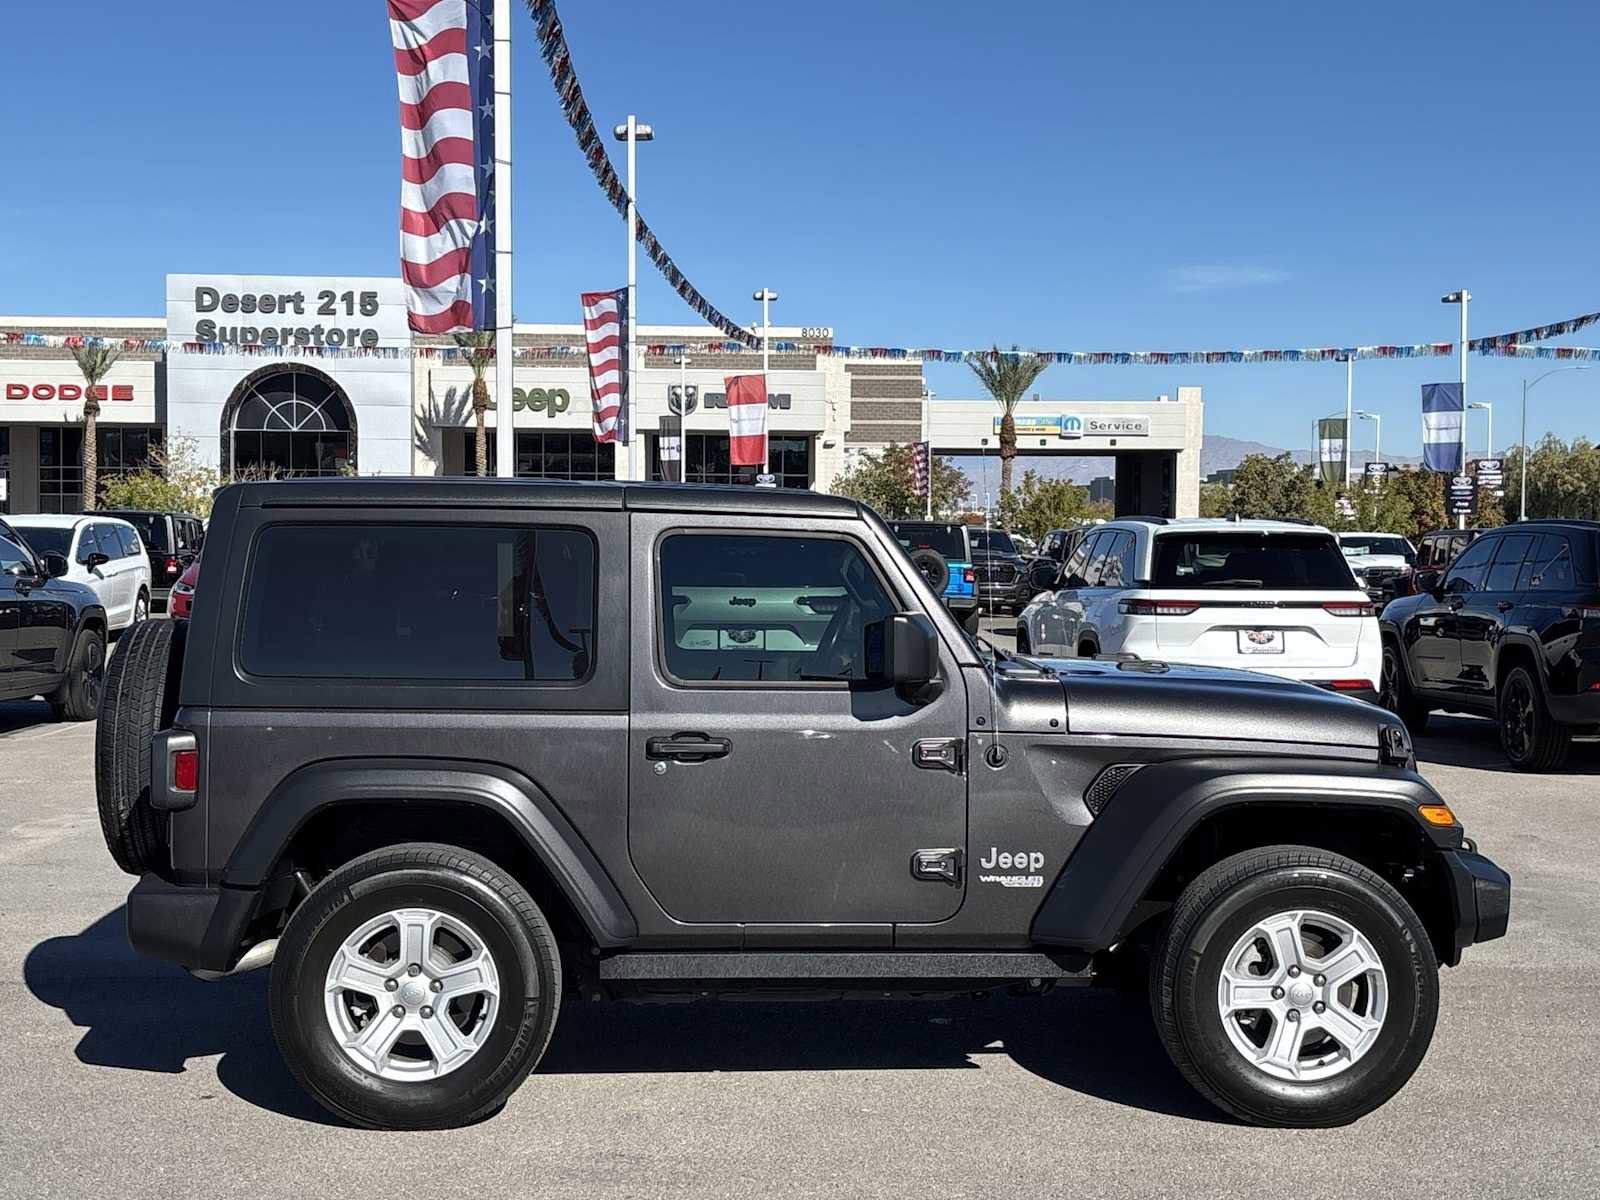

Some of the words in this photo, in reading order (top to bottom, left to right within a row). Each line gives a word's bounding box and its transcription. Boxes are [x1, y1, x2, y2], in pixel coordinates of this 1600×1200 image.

[195, 287, 304, 315] Desert
[317, 290, 379, 317] 215
[195, 319, 379, 347] Superstore
[801, 327, 829, 338] 8030
[486, 387, 570, 418] eep
[704, 392, 792, 410] RM
[1089, 420, 1143, 431] Service
[729, 596, 757, 607] Jeep
[980, 847, 1045, 873] Jeep
